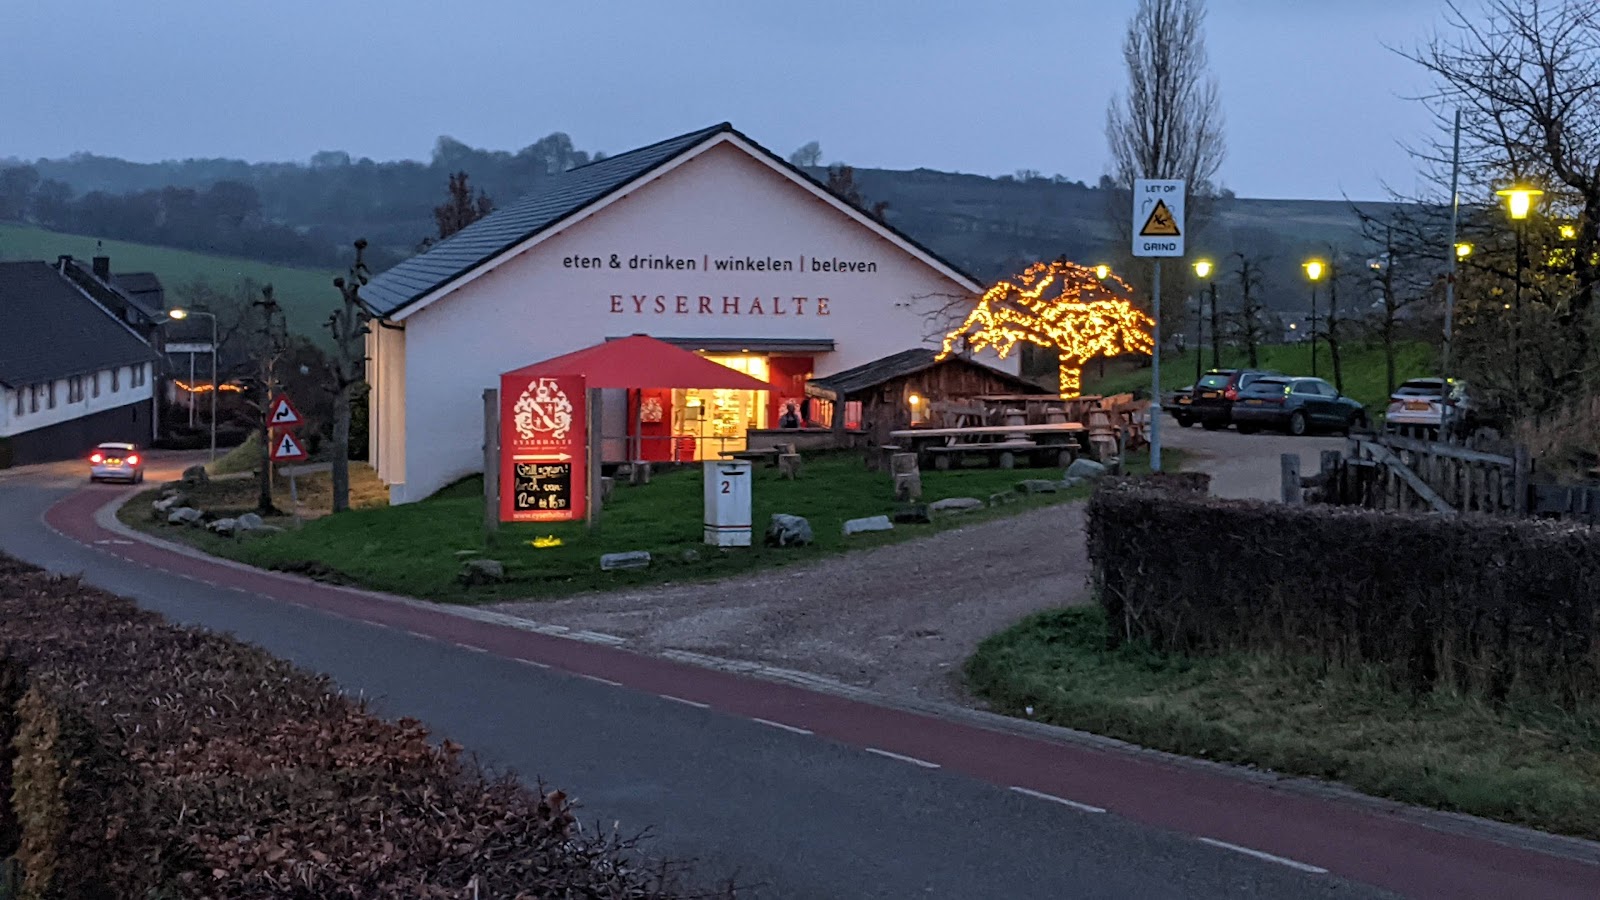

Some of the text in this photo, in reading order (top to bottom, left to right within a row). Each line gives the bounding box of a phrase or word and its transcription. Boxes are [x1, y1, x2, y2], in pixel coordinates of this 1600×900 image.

[1145, 185, 1176, 193] LET OP
[1143, 242, 1177, 251] GRIND
[562, 255, 601, 269] eten
[608, 254, 622, 269] &
[628, 254, 697, 270] drinken
[714, 255, 793, 272] winkelen
[811, 257, 877, 273] beleven
[609, 294, 832, 316] EYSERHALTE
[721, 480, 731, 494] 2
